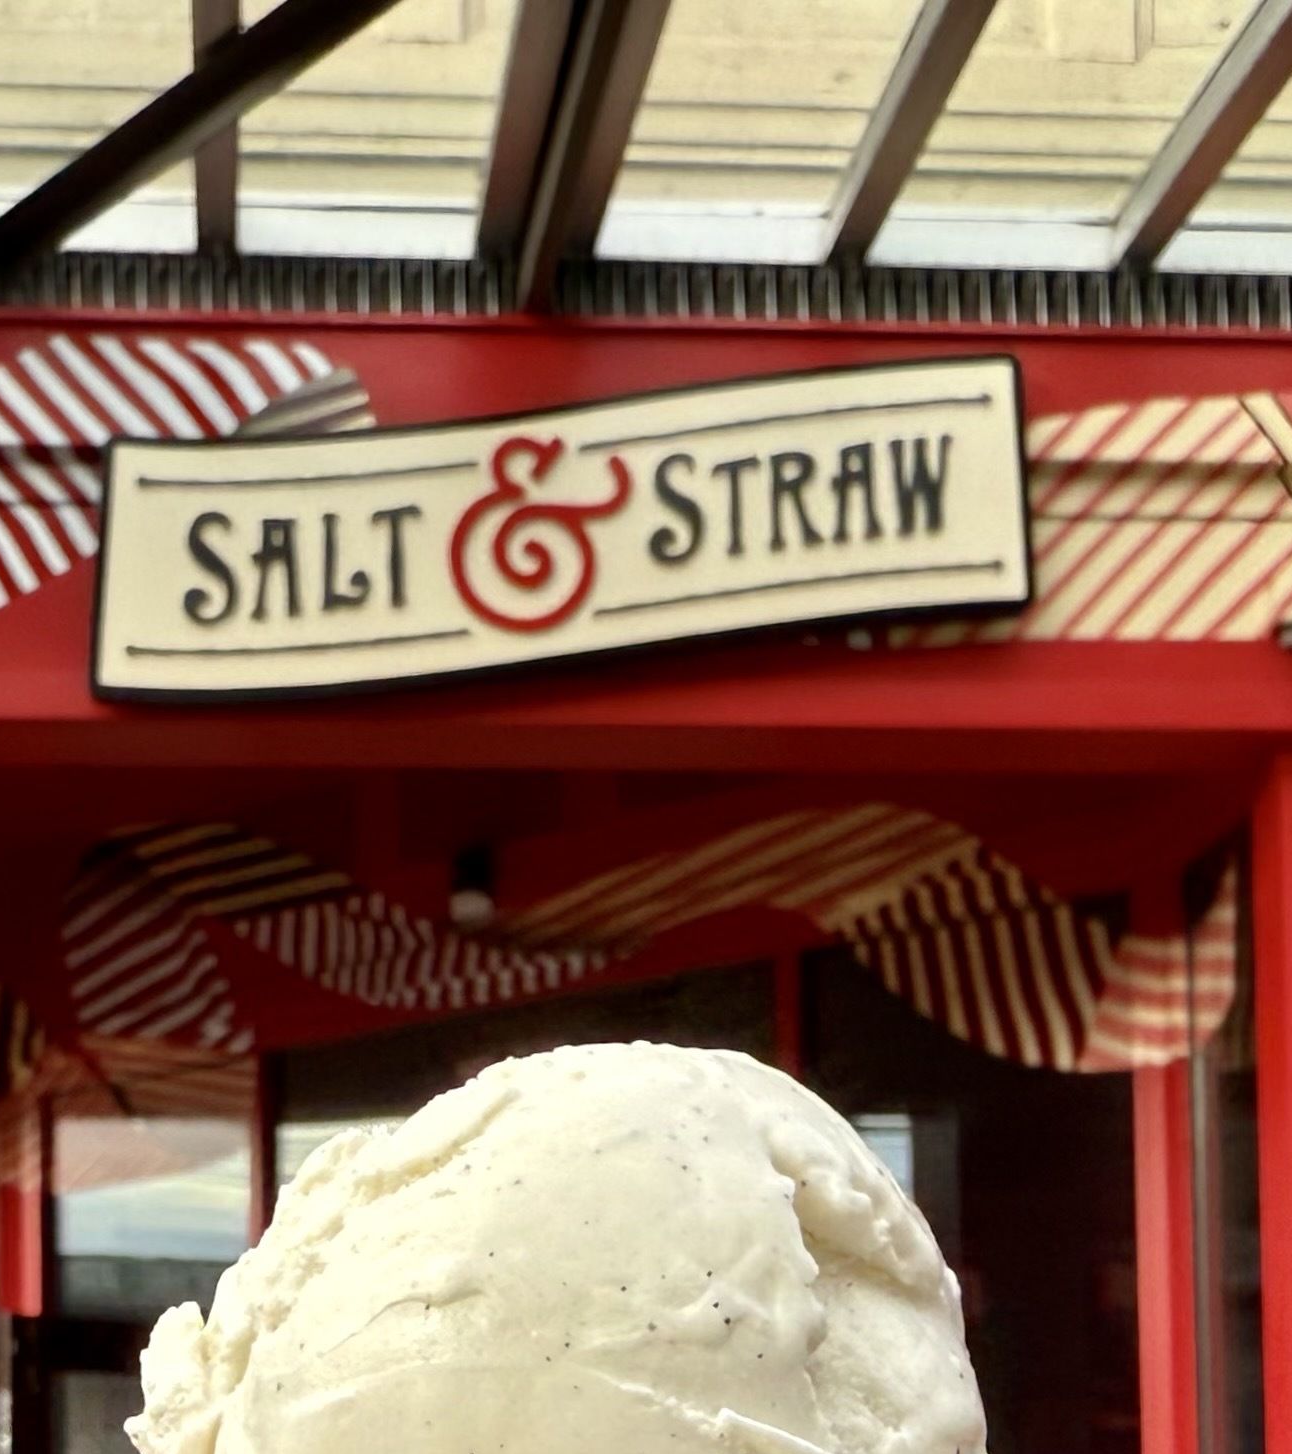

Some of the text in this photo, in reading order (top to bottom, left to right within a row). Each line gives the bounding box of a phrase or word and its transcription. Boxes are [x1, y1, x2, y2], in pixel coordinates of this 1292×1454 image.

[183, 435, 952, 634] SALT & STRAW
